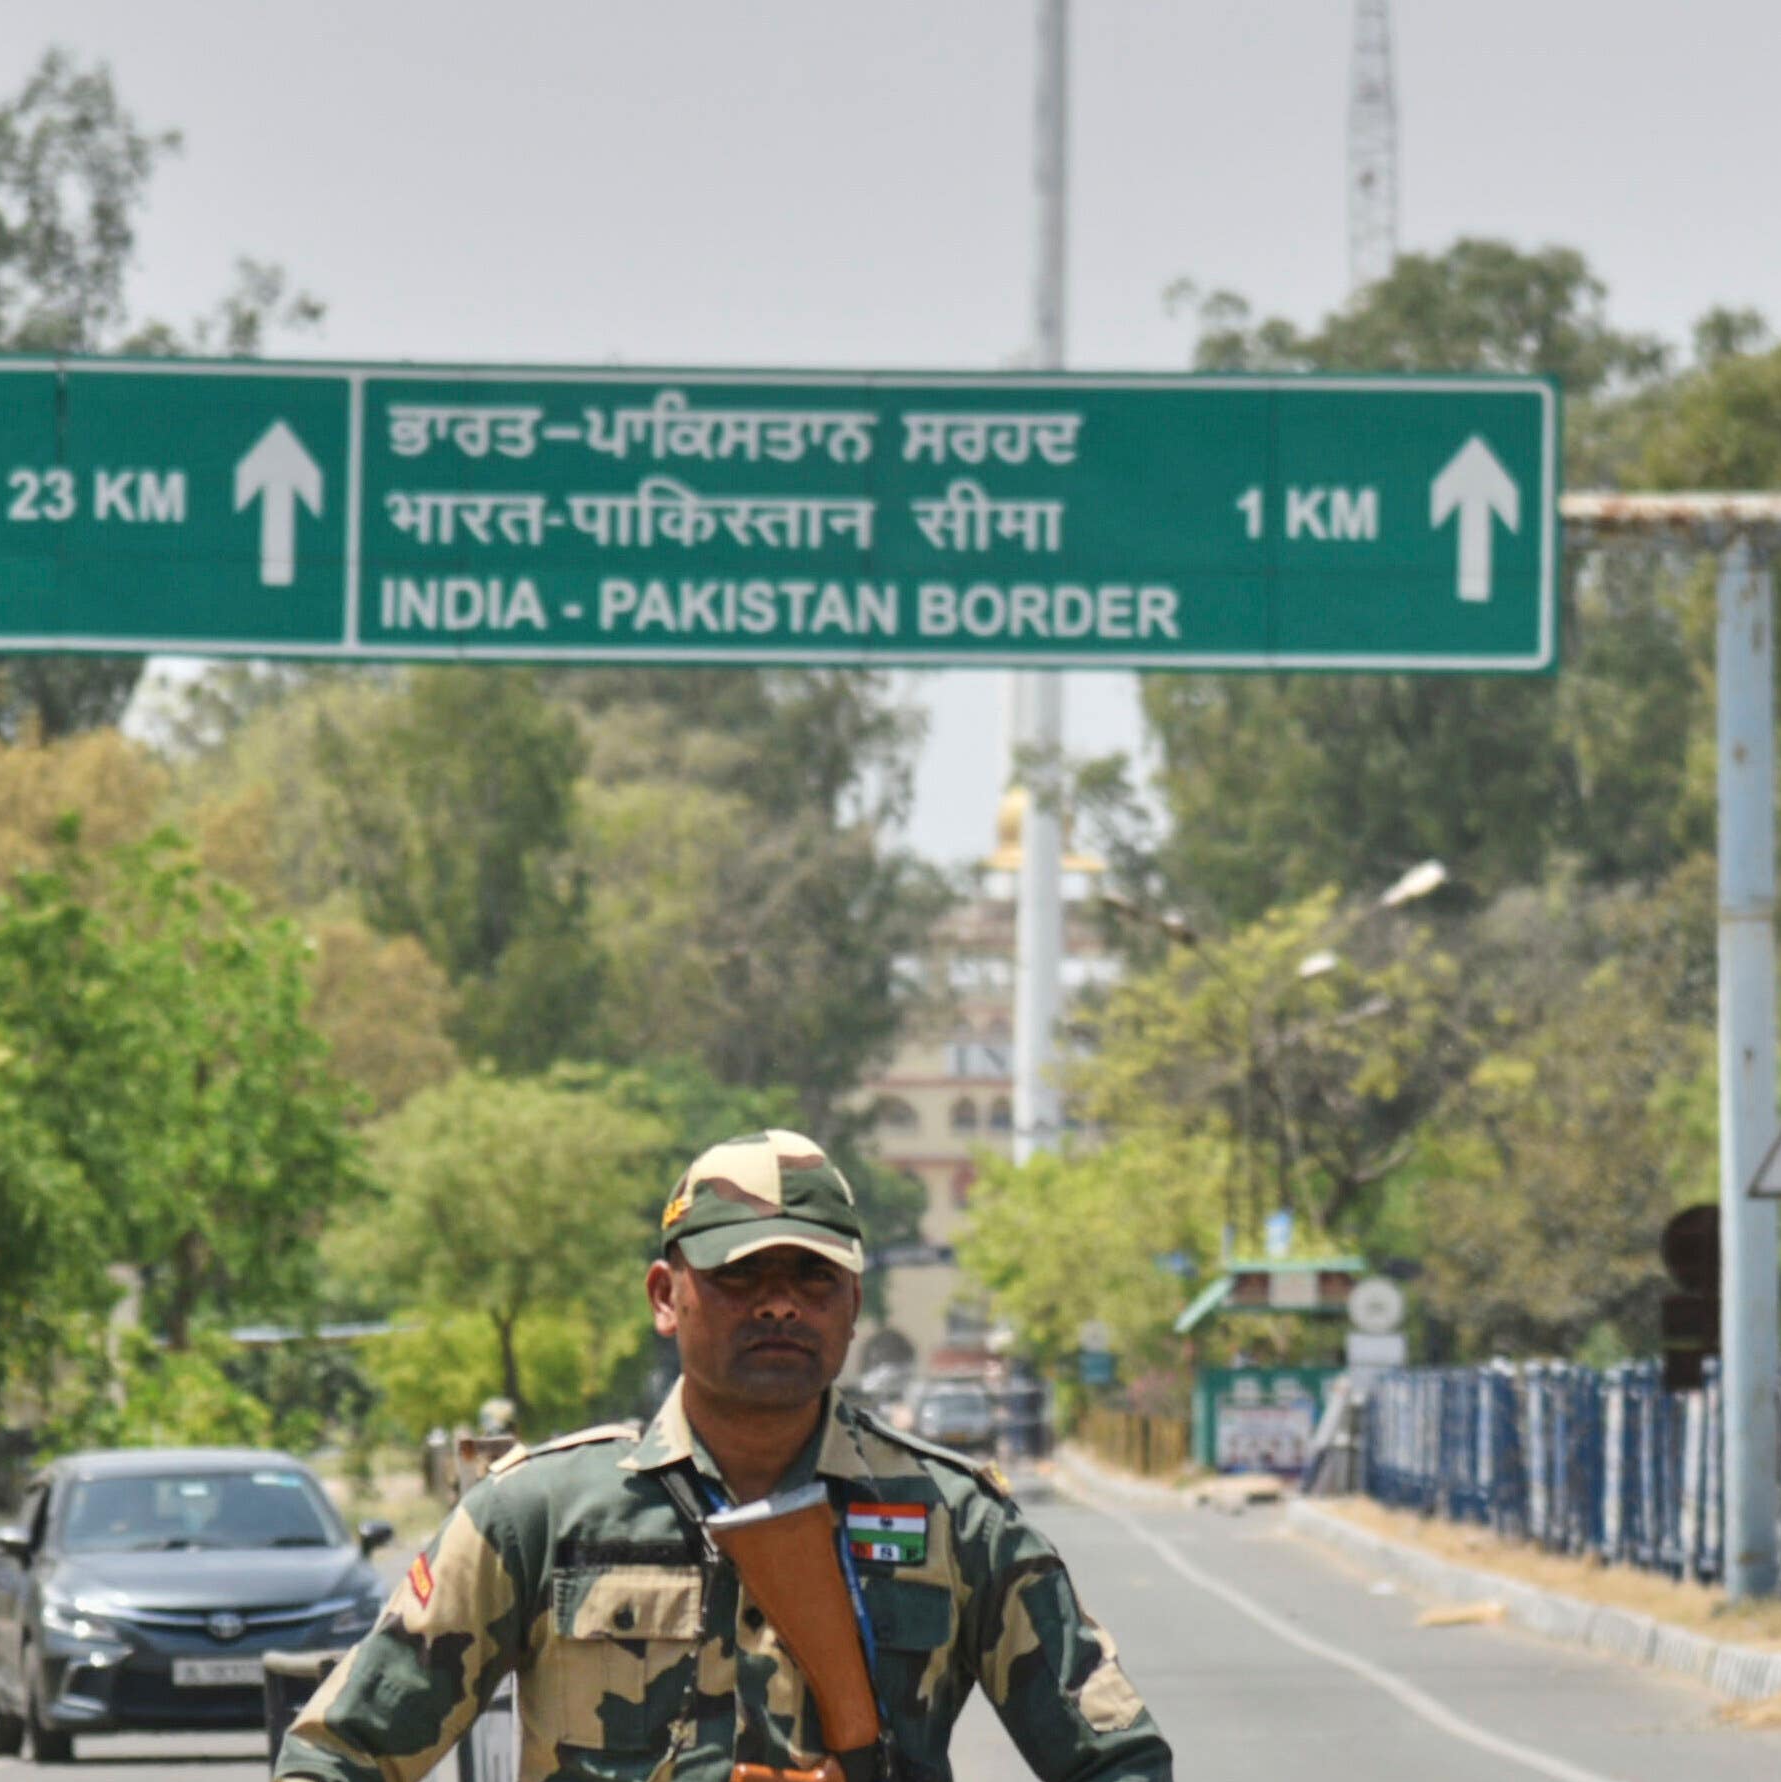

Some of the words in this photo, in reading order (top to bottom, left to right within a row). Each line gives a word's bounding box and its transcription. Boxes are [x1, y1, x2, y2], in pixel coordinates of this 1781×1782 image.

[902, 412, 1082, 464] ਸਰਹਦ
[8, 469, 76, 520] 23
[94, 470, 185, 522] KM
[385, 475, 875, 549] भारत-पाकिस्तान
[911, 478, 1064, 551] सीमा
[1237, 488, 1262, 538] 1
[1286, 488, 1377, 540] KM
[382, 578, 546, 630] INDIA
[600, 578, 898, 634] PAKISTAN
[918, 584, 1178, 638] BORDER
